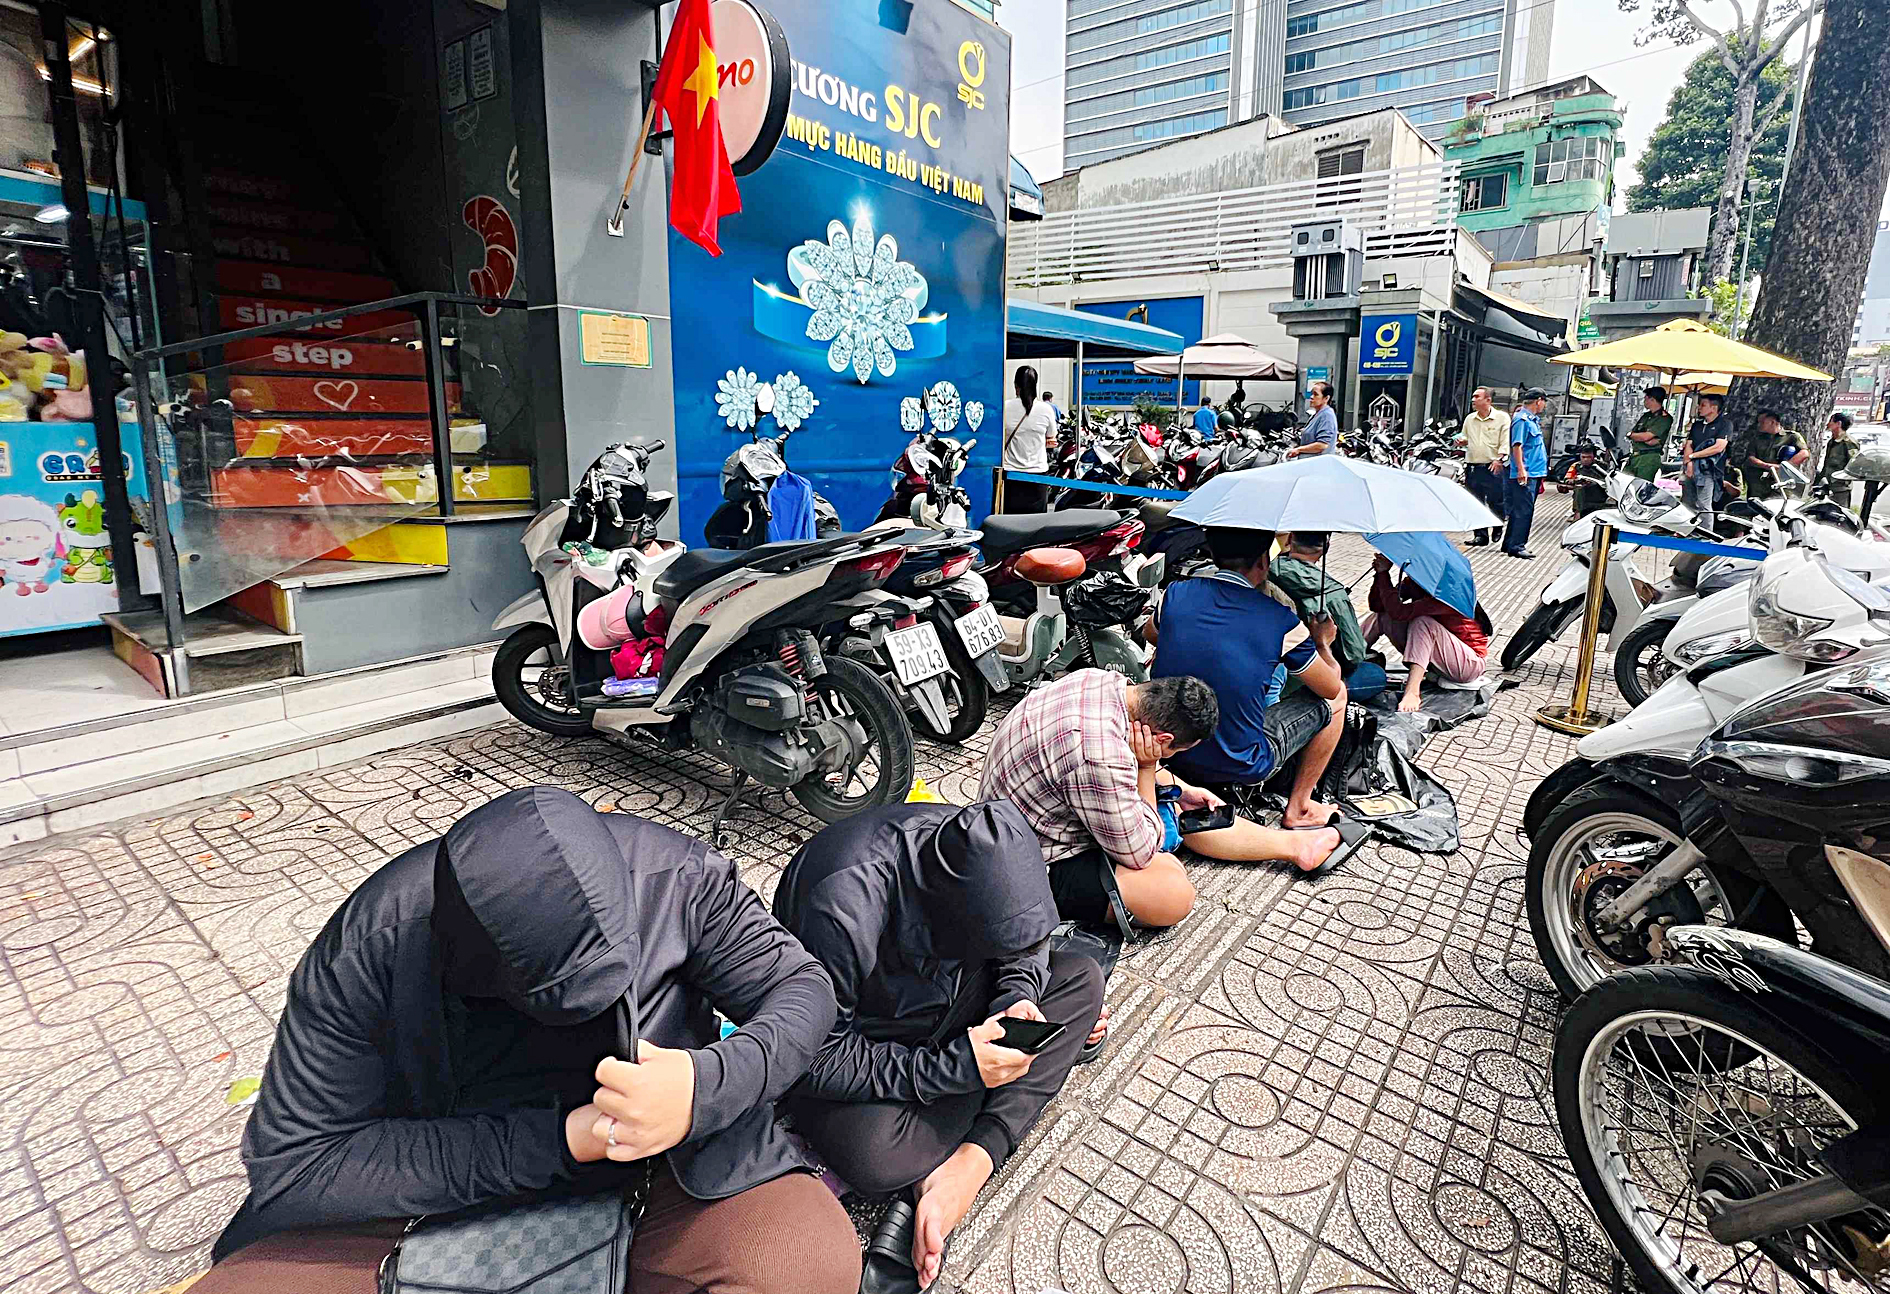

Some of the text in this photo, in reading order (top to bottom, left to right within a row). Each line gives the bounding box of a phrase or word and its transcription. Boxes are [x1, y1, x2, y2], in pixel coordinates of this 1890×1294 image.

[957, 83, 985, 111] SJC
[884, 84, 941, 149] SJC
[787, 113, 984, 206] MỰC HÀNG ĐẦU VIỆT NAM
[261, 272, 282, 290] a
[272, 342, 353, 369] step
[1373, 347, 1399, 360] SJC
[962, 610, 993, 636] 64-D1
[893, 628, 933, 656] 59-X3
[968, 624, 1003, 654] 676.83
[900, 649, 944, 681] 709.43
